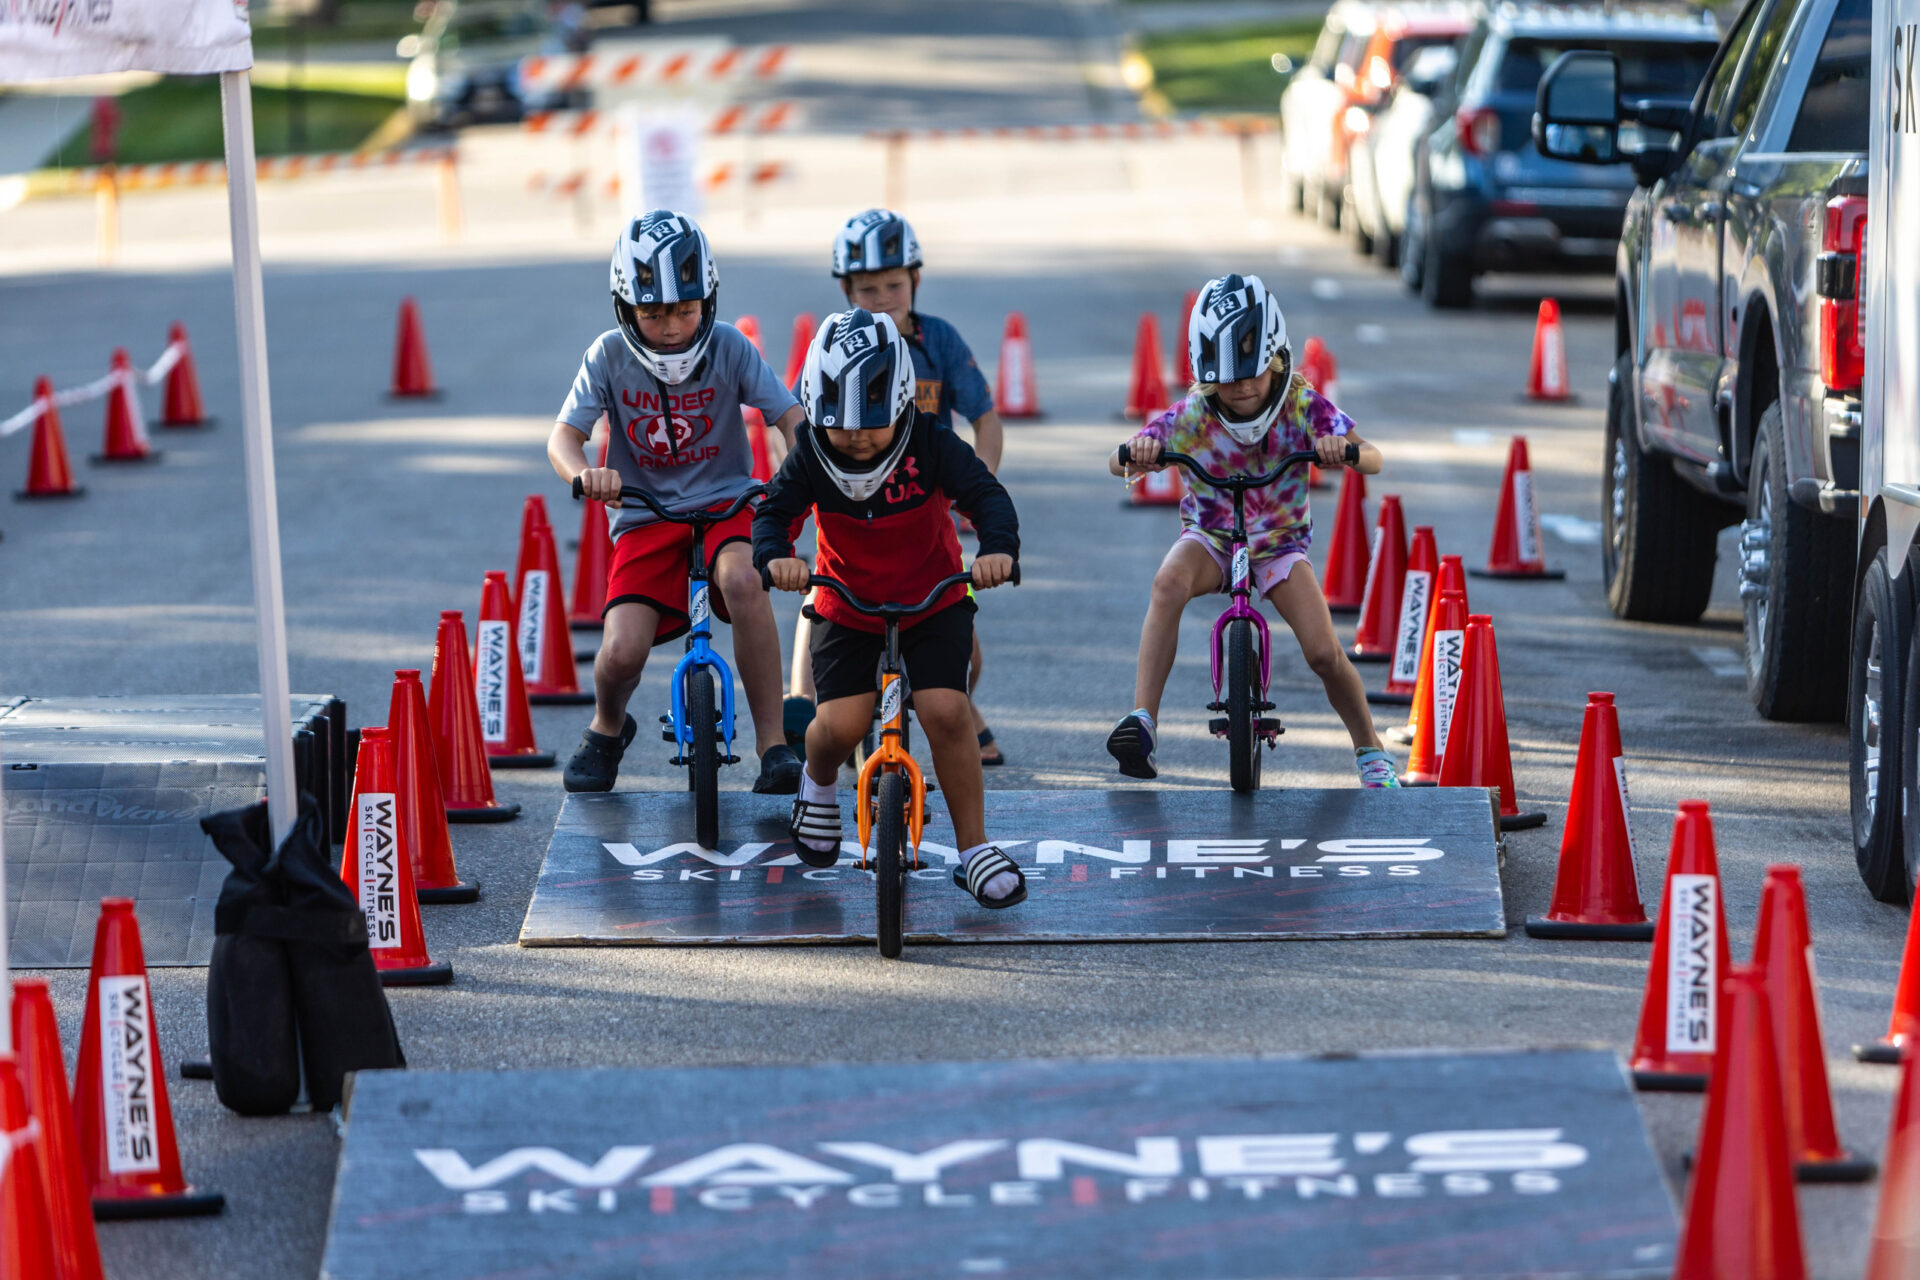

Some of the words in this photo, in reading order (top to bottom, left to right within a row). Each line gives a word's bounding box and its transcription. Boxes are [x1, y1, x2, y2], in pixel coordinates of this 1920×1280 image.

[622, 387, 715, 412] UNDER
[629, 446, 720, 469] ARMOUR
[885, 481, 926, 504] UA
[1403, 576, 1426, 676] WAYNE'S
[1438, 640, 1446, 657] SKI
[488, 626, 504, 735] WAYNE'S
[1438, 663, 1447, 696] CYCLE
[364, 805, 373, 826] SKI
[365, 834, 374, 876] CYCLE
[375, 799, 396, 942] WAYNE'S
[602, 838, 1446, 867] WAYNE'S
[631, 868, 740, 882] SKI
[802, 867, 1046, 882] CCE
[1110, 864, 1421, 880] FITNESS
[366, 885, 376, 938] FITNESS
[1690, 884, 1709, 1042] WAYNE'S
[123, 984, 151, 1161] WAYNE'S
[415, 1128, 1588, 1189] WAYNE'S
[463, 1186, 617, 1214] SKI
[701, 1179, 1040, 1206] CYCLE
[1126, 1169, 1561, 1202] FITNESS
